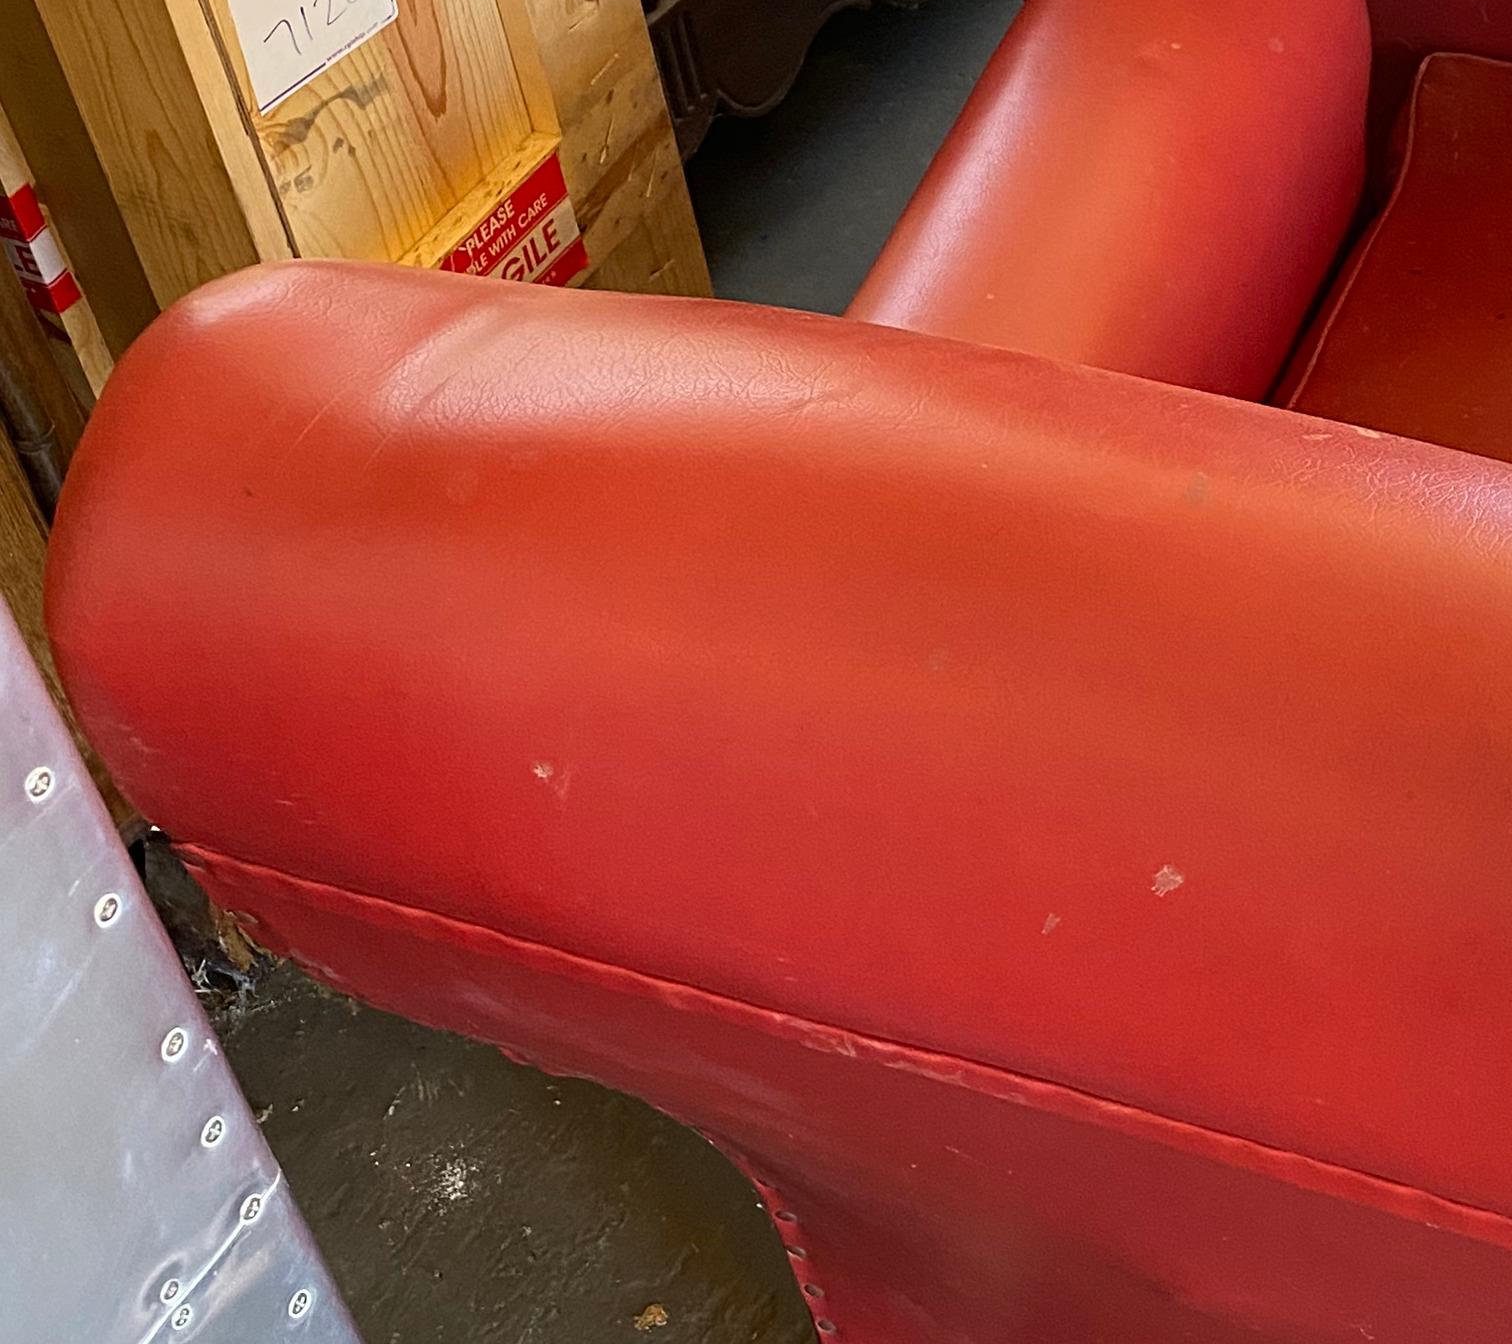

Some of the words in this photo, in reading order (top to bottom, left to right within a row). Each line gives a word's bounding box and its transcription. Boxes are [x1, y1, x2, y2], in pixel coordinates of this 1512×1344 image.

[465, 199, 516, 257] PLEASE
[488, 225, 516, 256] WITH
[517, 192, 549, 228] CARE
